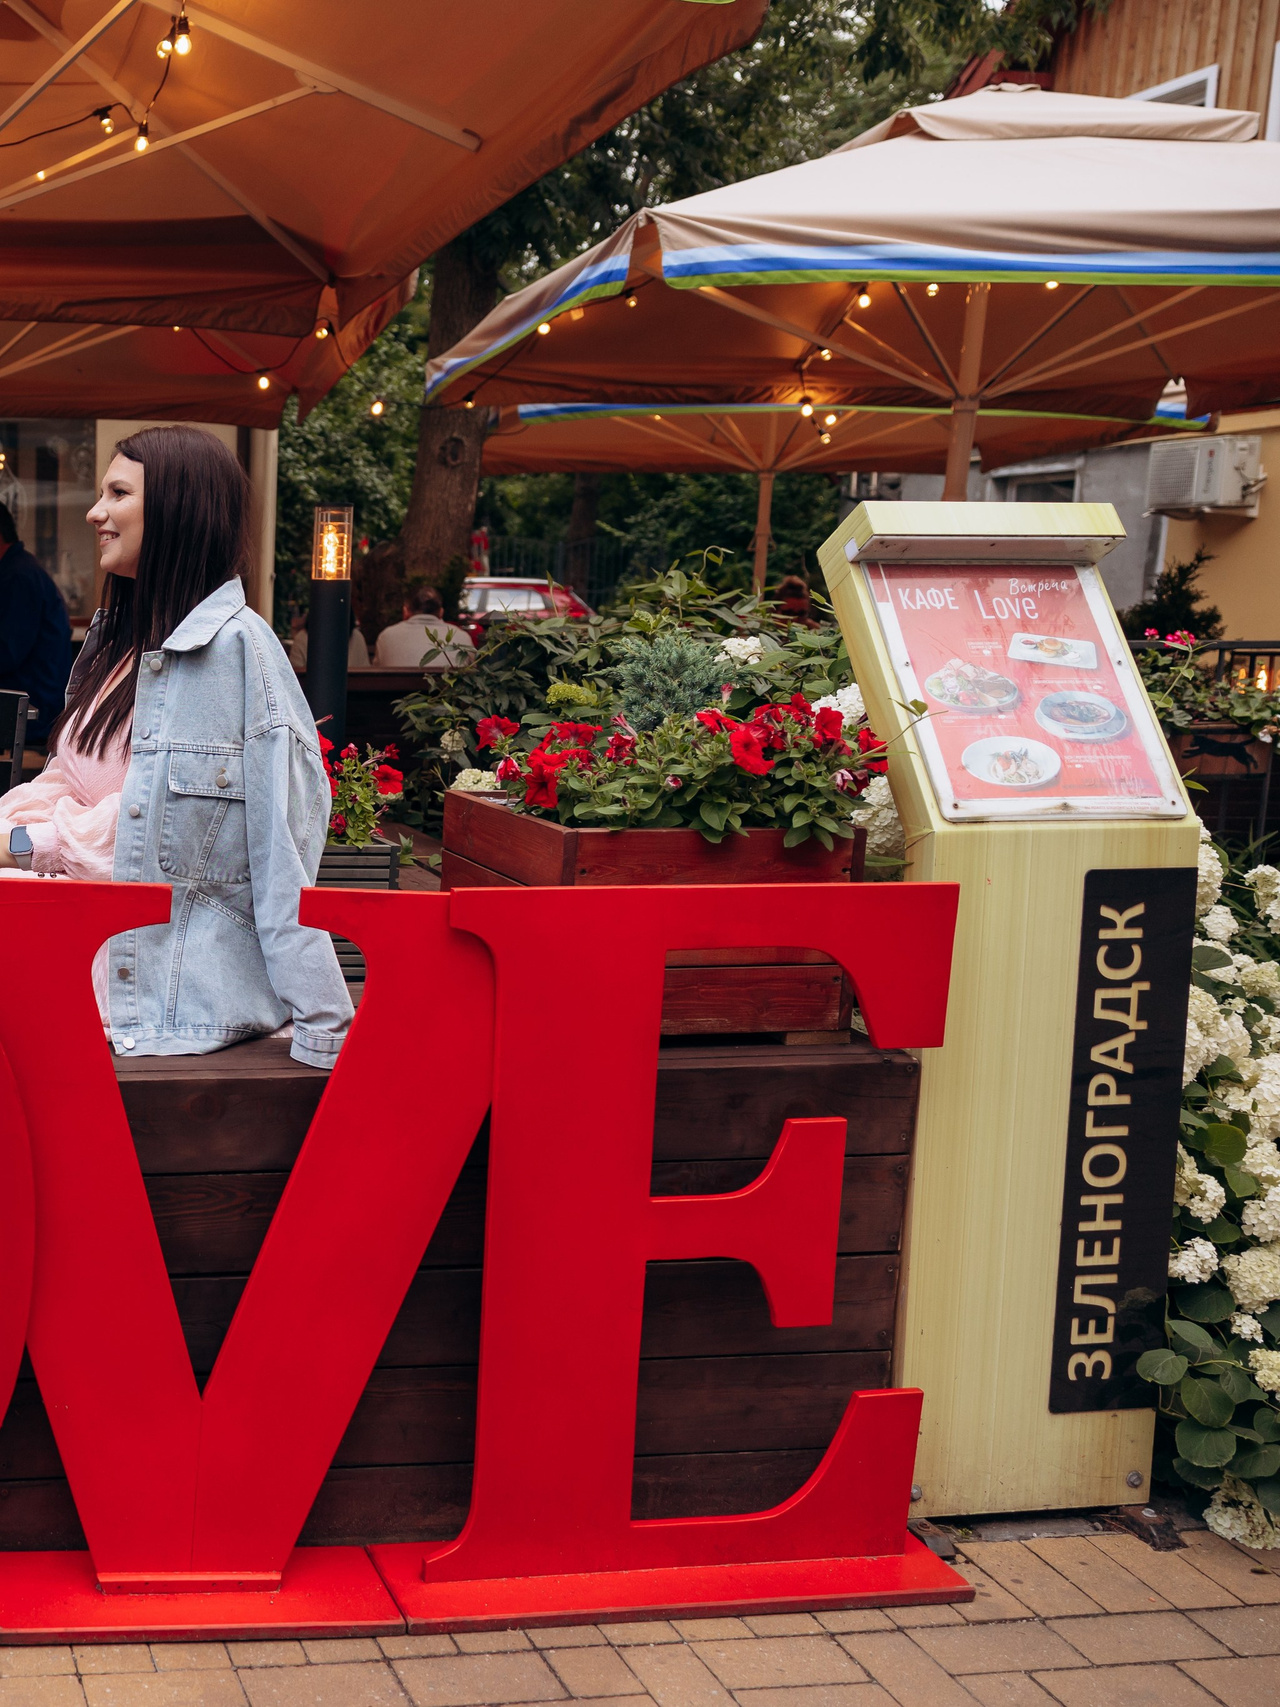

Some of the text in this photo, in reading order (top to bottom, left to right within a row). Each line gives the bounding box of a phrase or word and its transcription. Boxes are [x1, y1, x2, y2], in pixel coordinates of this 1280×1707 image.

[1009, 578, 1069, 597] Встреча
[898, 588, 1039, 619] КАФЕ Love
[1067, 902, 1151, 1380] ЗЕЛЕНОГРАДСК
